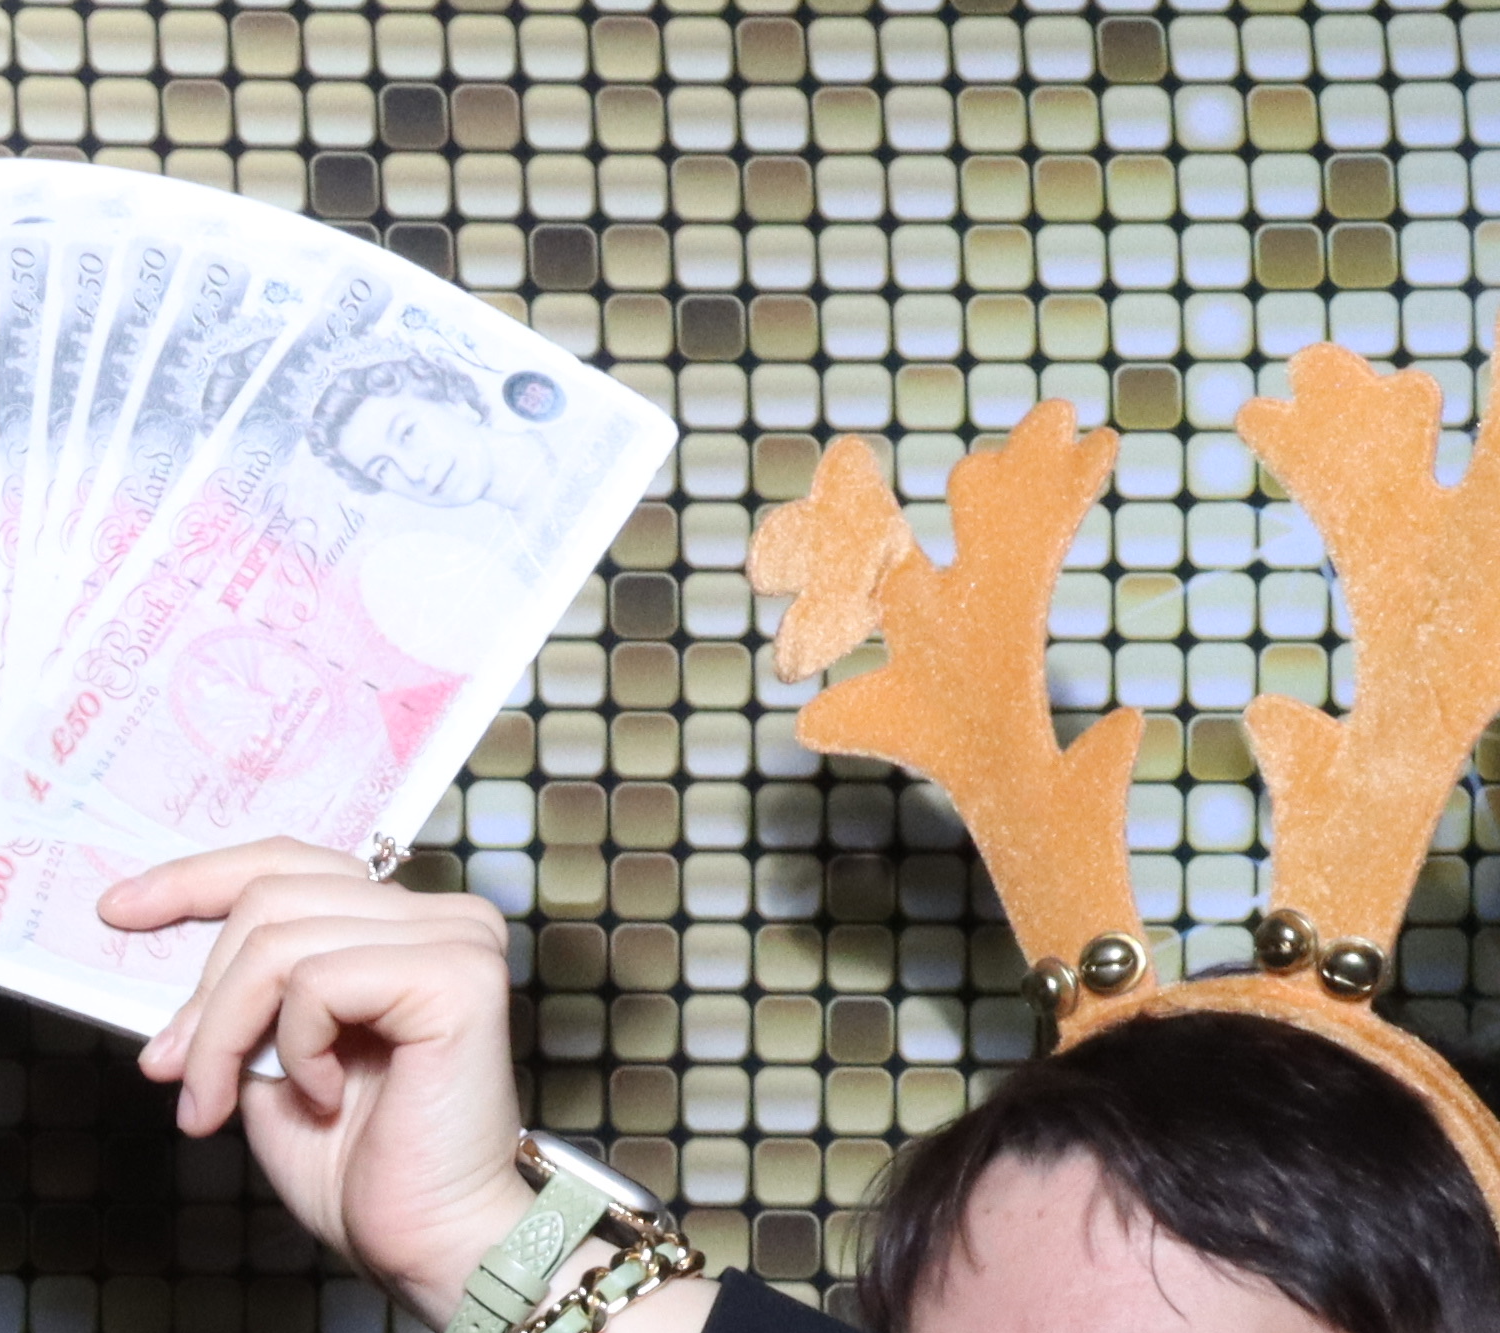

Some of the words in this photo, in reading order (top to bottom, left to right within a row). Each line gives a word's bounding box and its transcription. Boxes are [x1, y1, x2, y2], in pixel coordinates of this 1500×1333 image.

[11, 246, 38, 324] £50
[77, 252, 103, 324] £50
[133, 246, 167, 320] £50
[192, 262, 230, 330] £50
[326, 277, 373, 341] £50
[170, 449, 273, 577] England
[217, 505, 297, 613] FIFTY
[264, 502, 366, 631] Pounds
[49, 690, 103, 766] £50
[88, 750, 118, 783] N34
[116, 684, 161, 746] 202220
[22, 909, 44, 942] N34
